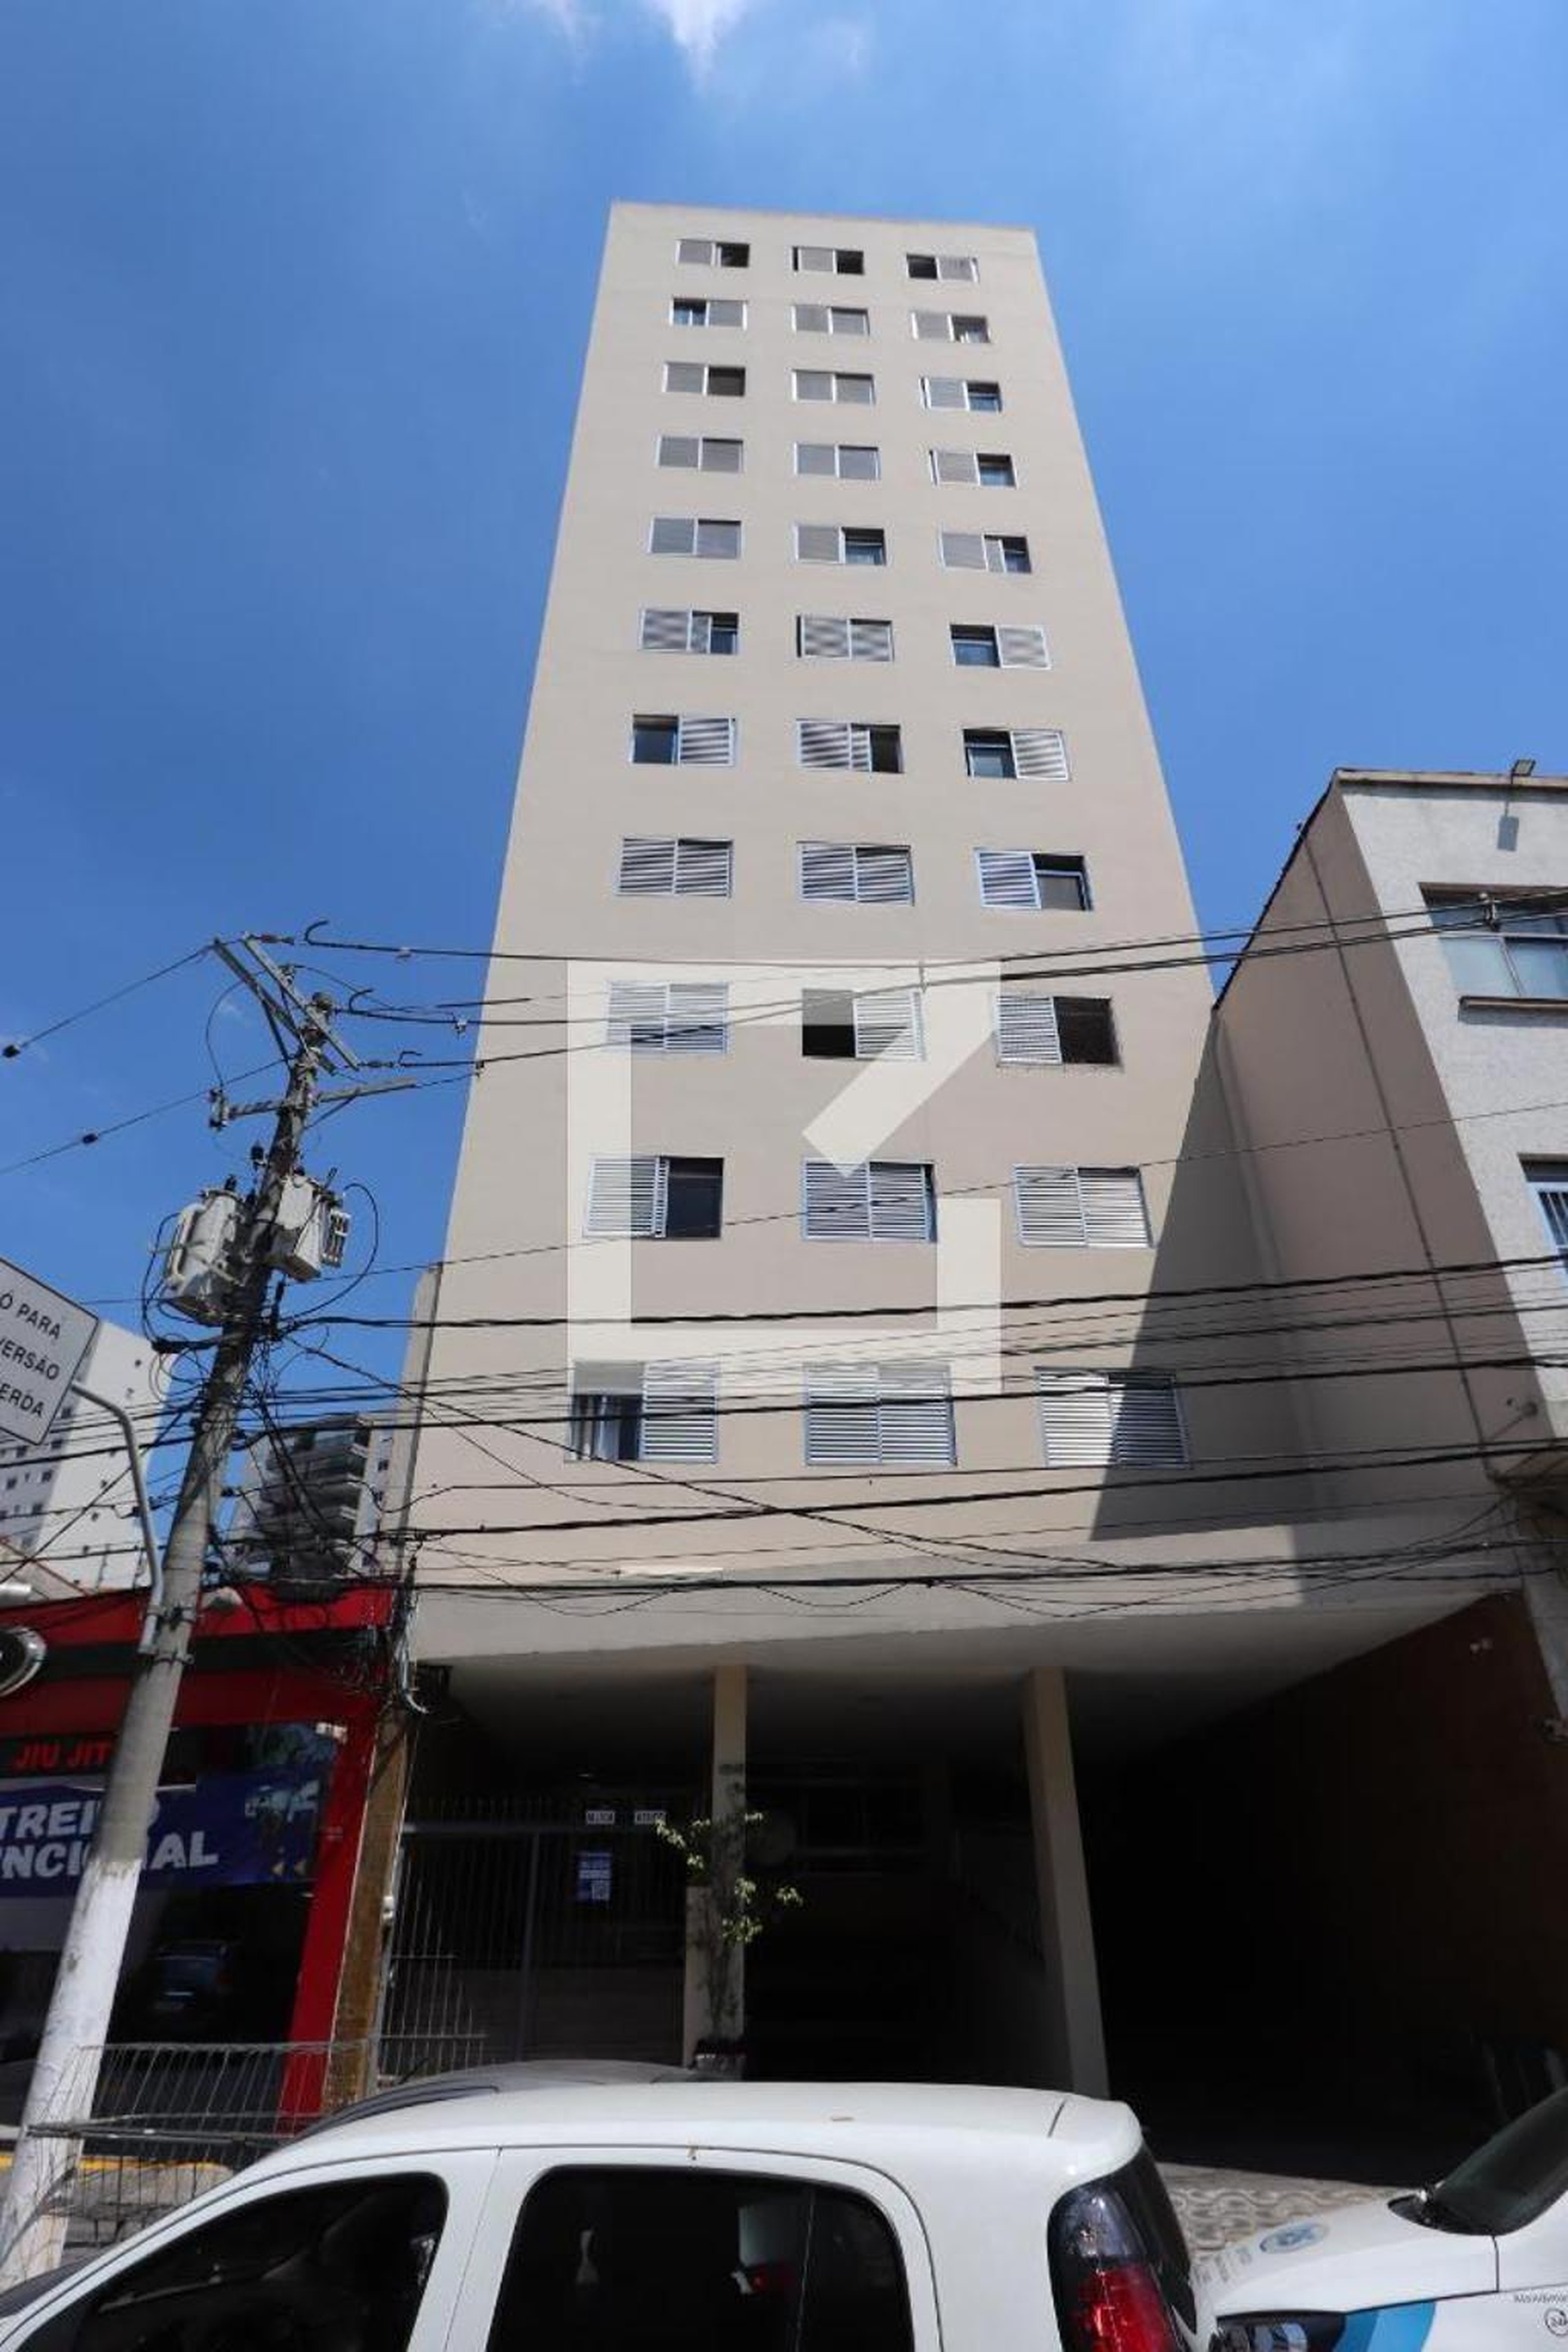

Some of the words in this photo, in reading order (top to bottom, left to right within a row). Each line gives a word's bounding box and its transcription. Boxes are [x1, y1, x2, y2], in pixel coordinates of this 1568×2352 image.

[16, 1303, 61, 1340] PARA
[0, 1383, 43, 1418] ERDA
[16, 1740, 60, 1770] JIU
[67, 1740, 113, 1767] JIT
[0, 1800, 160, 1838] TREI
[1, 1831, 219, 1878] NCIAL
